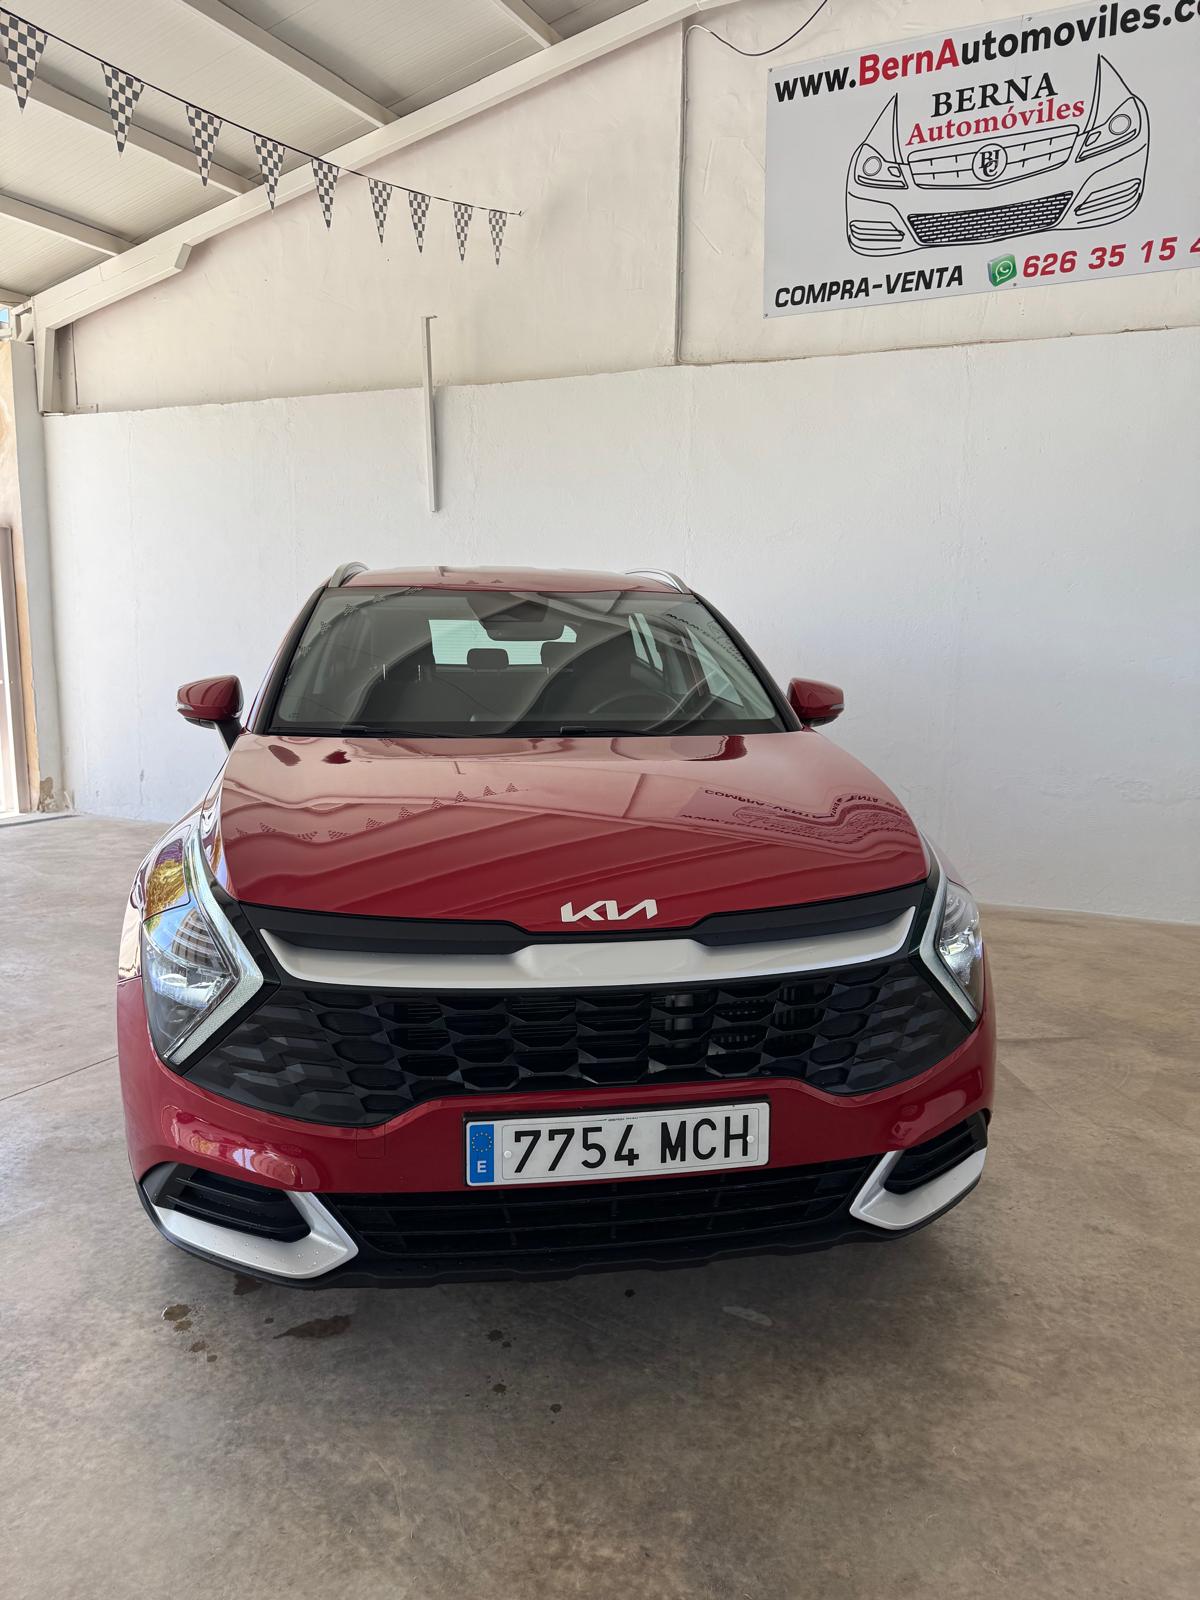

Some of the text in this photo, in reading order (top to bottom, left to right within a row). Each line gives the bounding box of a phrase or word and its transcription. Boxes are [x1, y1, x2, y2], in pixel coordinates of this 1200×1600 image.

[774, 0, 1200, 103] www.BernAutomoviles.c
[931, 72, 1058, 117] BERNA
[905, 97, 1085, 146] Automóviles
[1023, 250, 1078, 278] 626
[1088, 244, 1126, 270] 35
[1141, 236, 1178, 263] 15
[775, 265, 963, 308] COMPRA-VENTA
[514, 1114, 749, 1173] 7754 MCH
[477, 1160, 487, 1173] E
